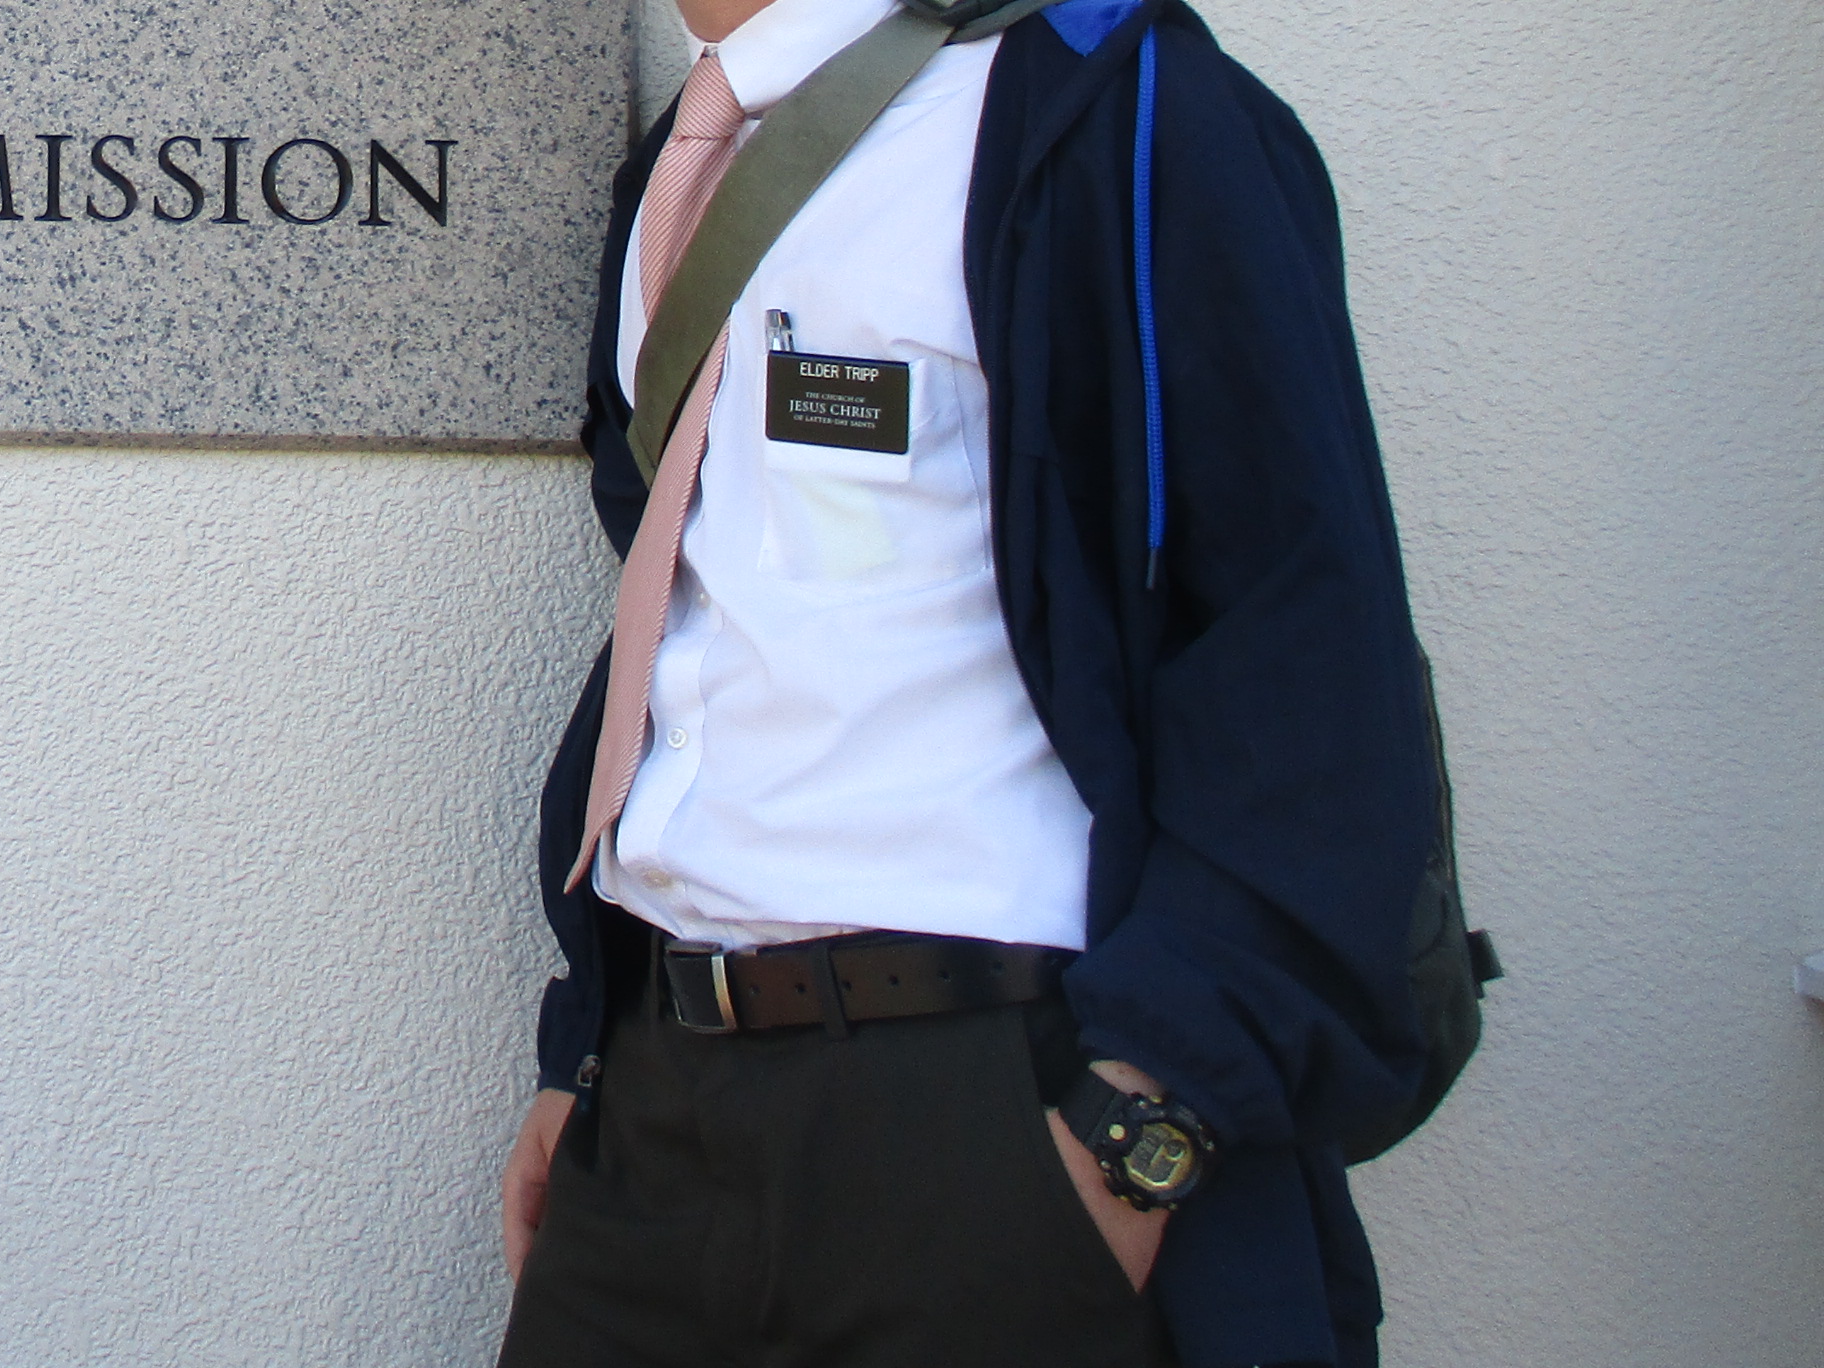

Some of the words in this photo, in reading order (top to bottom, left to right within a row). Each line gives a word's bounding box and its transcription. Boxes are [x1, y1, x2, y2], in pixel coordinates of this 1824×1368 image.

[800, 362, 839, 379] ELDER
[844, 366, 879, 382] TRIPP
[789, 400, 826, 413] JESUS
[830, 404, 881, 419] CHRIST
